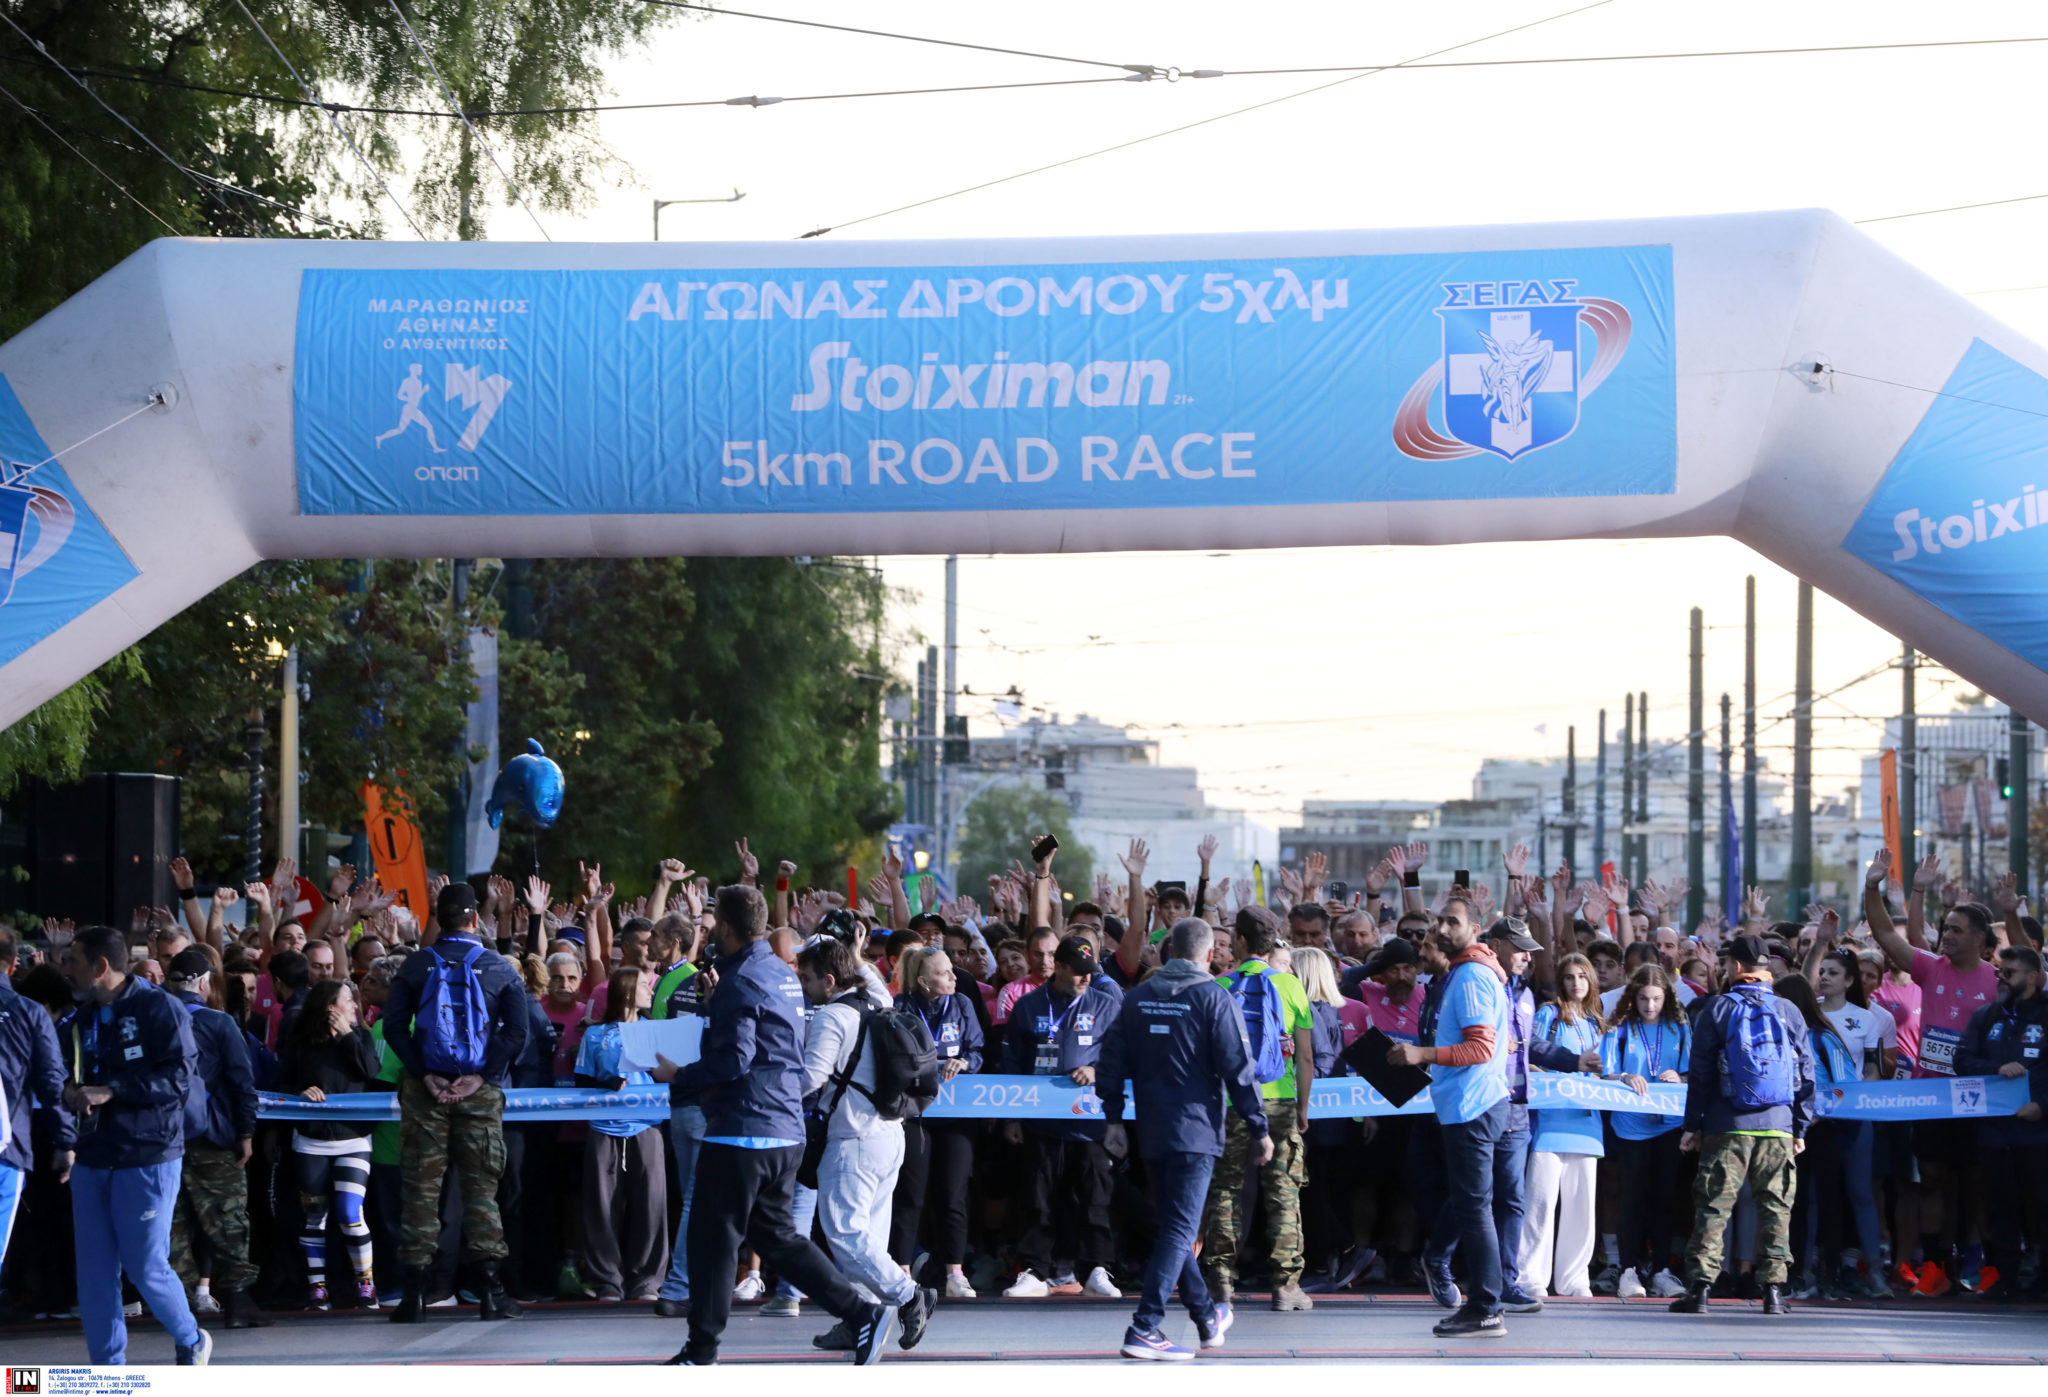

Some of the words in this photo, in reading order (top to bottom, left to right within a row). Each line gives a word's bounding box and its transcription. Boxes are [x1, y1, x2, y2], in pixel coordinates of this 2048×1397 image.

[626, 279, 888, 321] ΑΓΩΝΑΣ
[897, 274, 1191, 318] ΔΡΟΜΟΥ
[1200, 267, 1348, 324] 5χλμ
[1441, 279, 1578, 307] ΣΕΓΑΣ
[368, 299, 529, 313] ΜΑΡΑΘΩΝΙΟΣ
[397, 317, 498, 333] ΑΘΗΝΑΣ
[400, 338, 508, 350] ΑΥΘΕΝΤΙΚΟΣ
[791, 341, 1171, 412] Stoiximan
[1173, 394, 1195, 405] 21+
[720, 439, 852, 487] 5km
[868, 437, 1059, 484] ROAD
[1080, 432, 1256, 482] RACE
[972, 1084, 1040, 1107] 2024
[1855, 1094, 1938, 1110] Stoiximan
